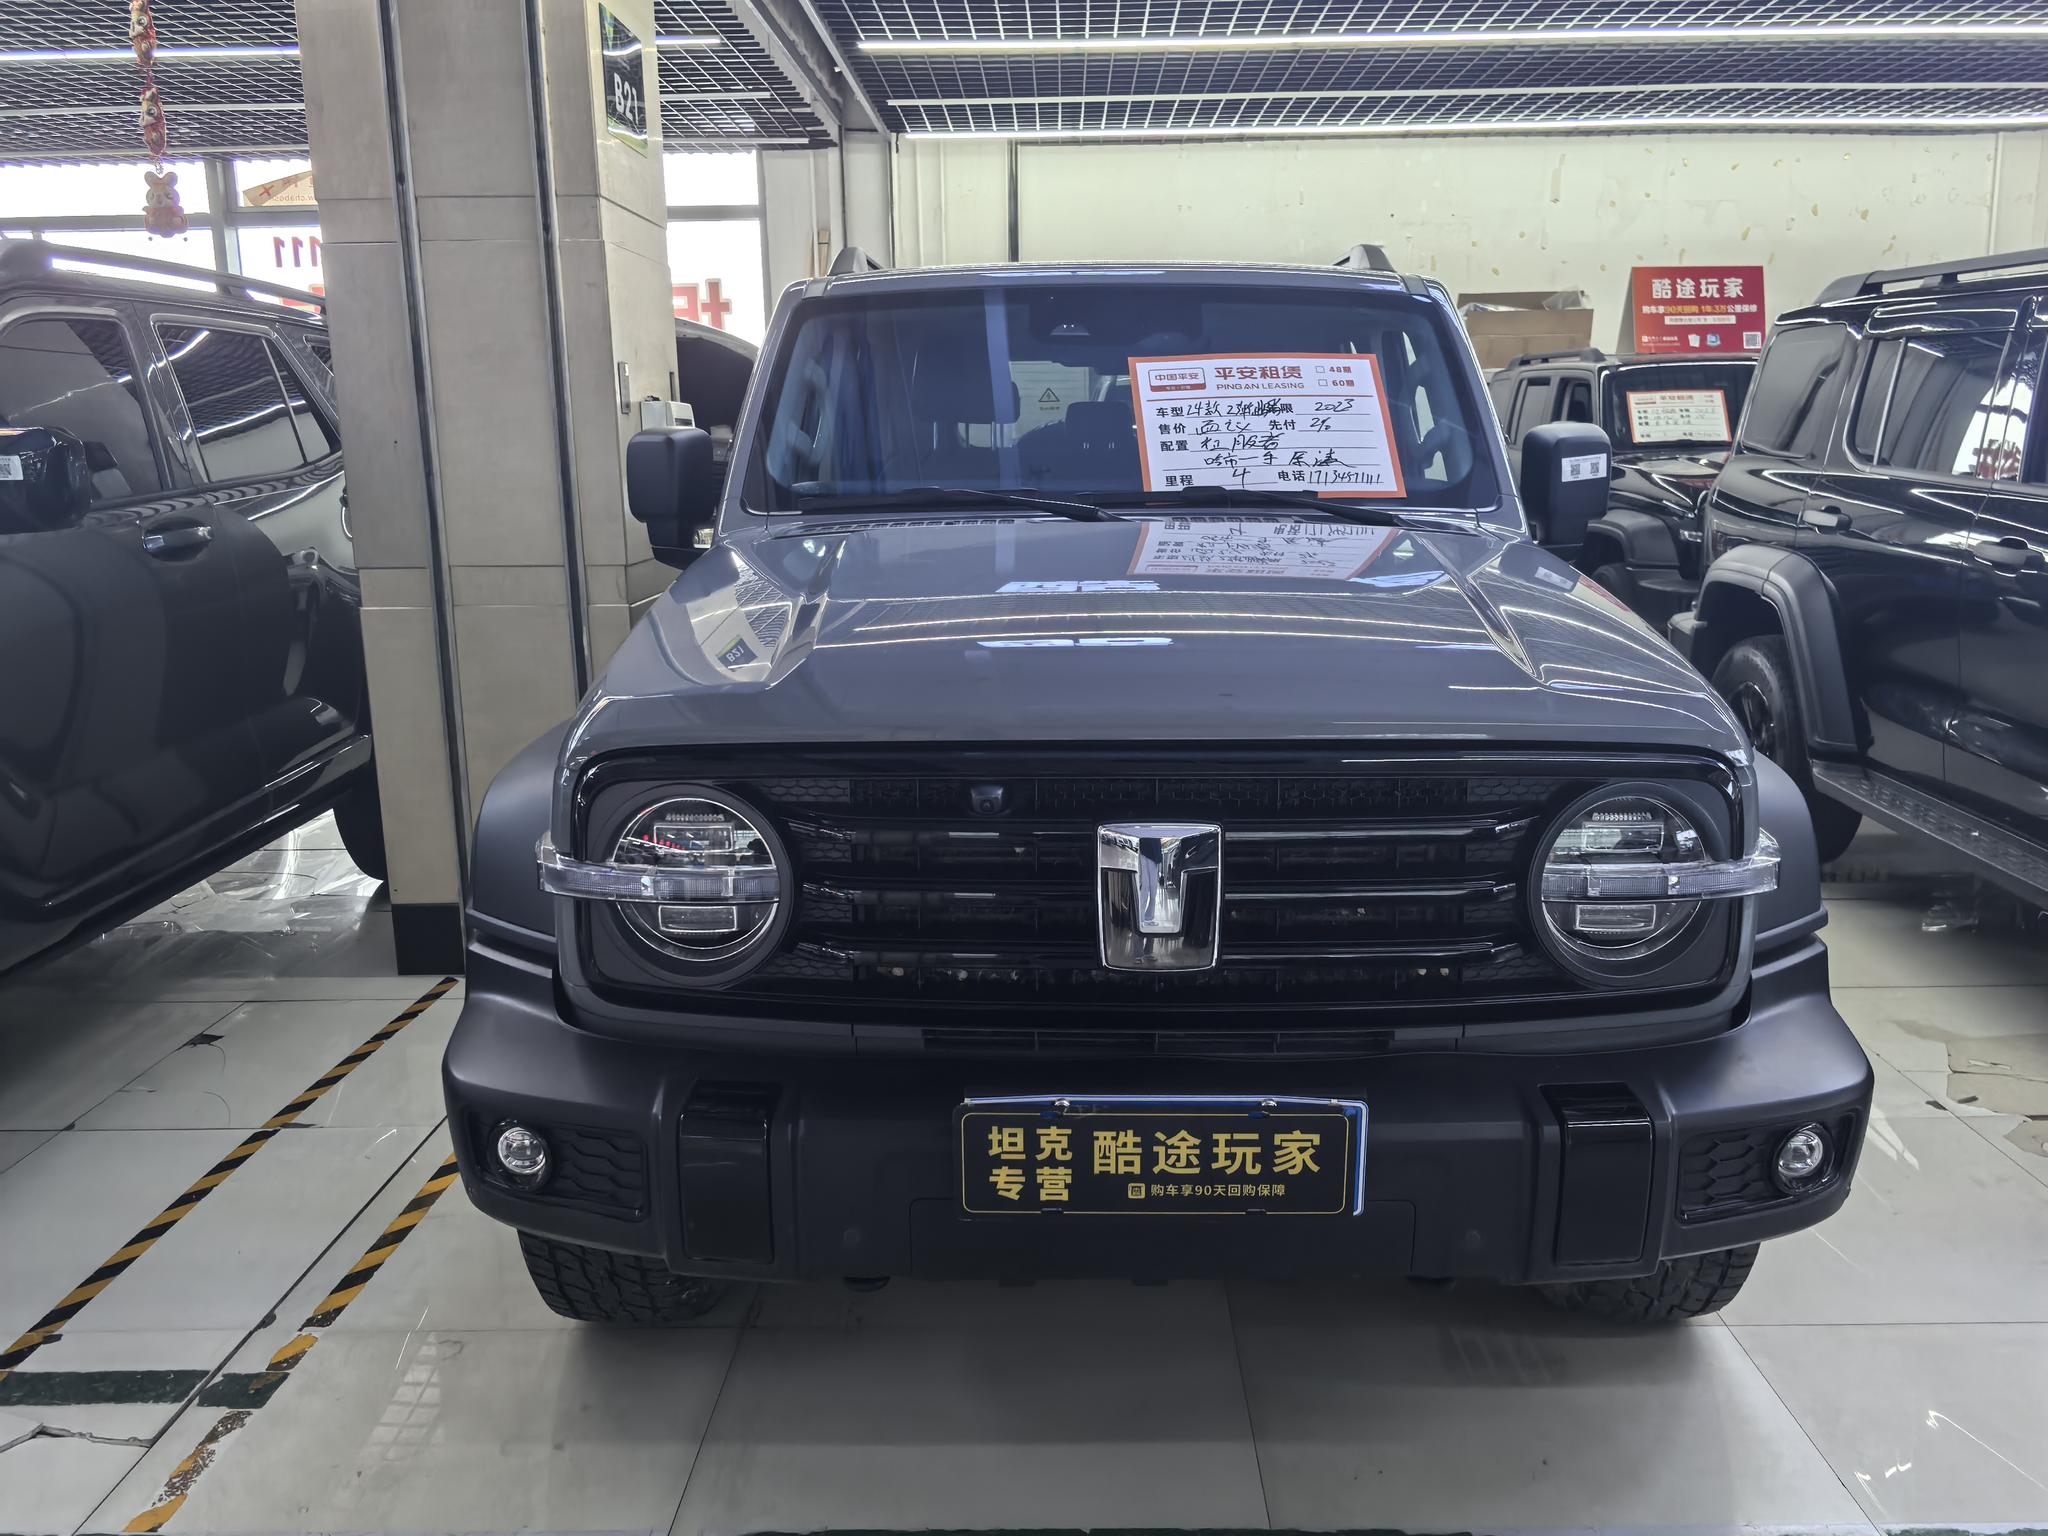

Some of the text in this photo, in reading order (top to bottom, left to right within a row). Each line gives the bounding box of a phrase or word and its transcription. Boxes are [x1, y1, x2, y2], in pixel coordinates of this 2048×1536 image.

[614, 72, 639, 126] B21
[1651, 277, 1745, 299] 酷途玩家
[1154, 372, 1200, 382] 中国平安
[1215, 365, 1304, 380] 平安租赁
[1262, 382, 1305, 390] LEASING
[1156, 406, 1184, 417] 车型
[1314, 398, 1355, 412] 2023
[1158, 423, 1187, 435] 售价
[1268, 418, 1296, 431] 先付
[1160, 439, 1190, 452] 配置
[1165, 474, 1194, 487] 里程
[1277, 470, 1305, 482] 电话
[988, 1125, 1073, 1162] 坦克
[1093, 1129, 1321, 1176] 酷途玩家
[989, 1166, 1073, 1202] 专营
[1150, 1184, 1286, 1197] 购车享90天回购保障
